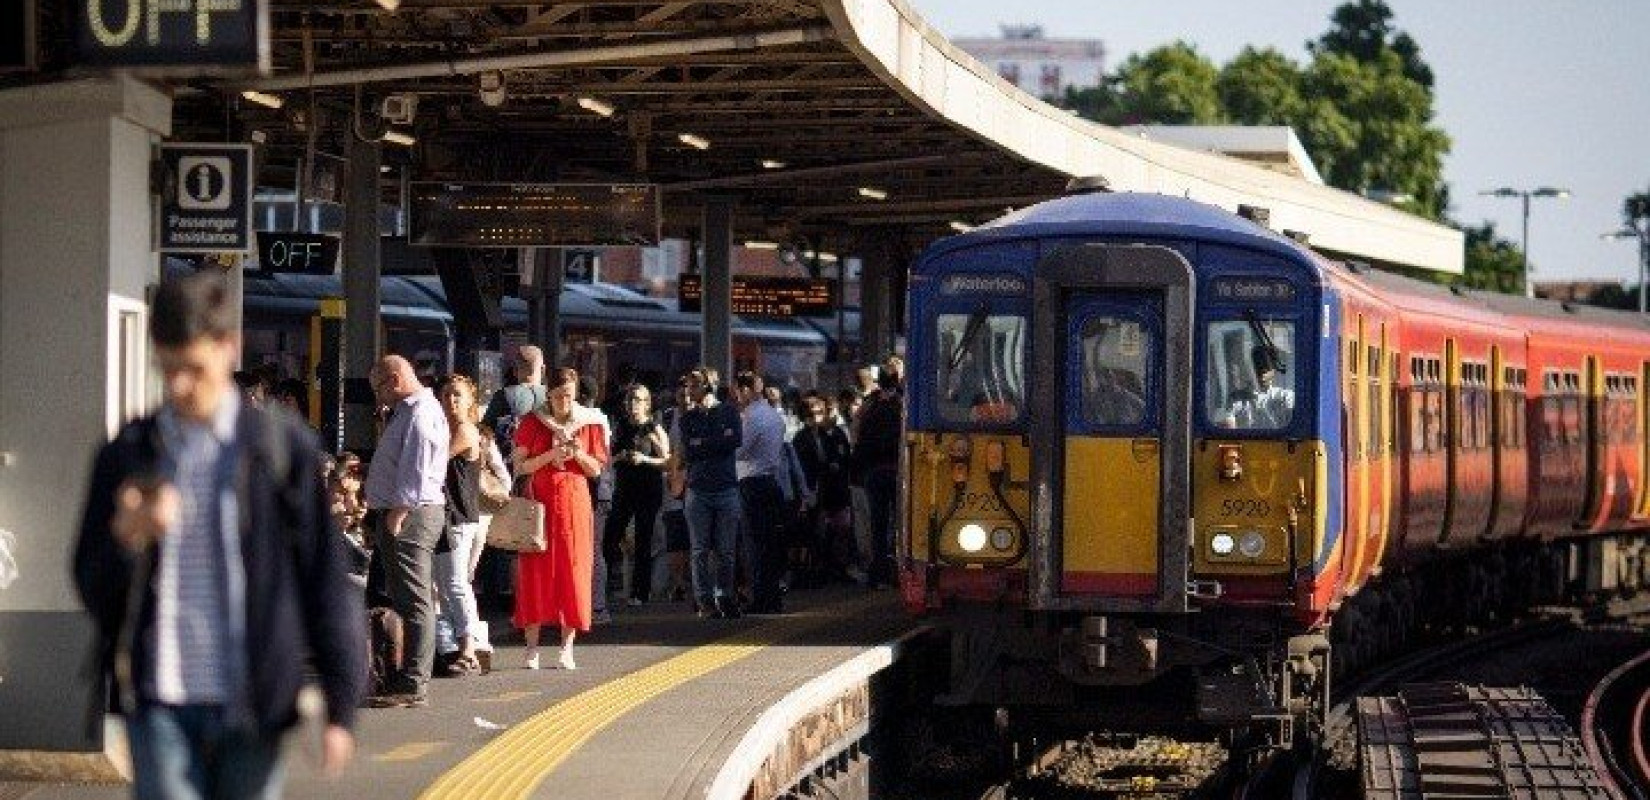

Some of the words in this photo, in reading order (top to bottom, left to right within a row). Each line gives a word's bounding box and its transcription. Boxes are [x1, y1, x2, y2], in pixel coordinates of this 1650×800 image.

[87, 0, 243, 46] OFF
[167, 214, 238, 232] Passenger
[170, 231, 238, 244] assistance
[270, 240, 322, 267] OFF
[567, 254, 588, 277] 4
[950, 275, 1025, 291] Waterloo
[1221, 499, 1270, 518] 5920
